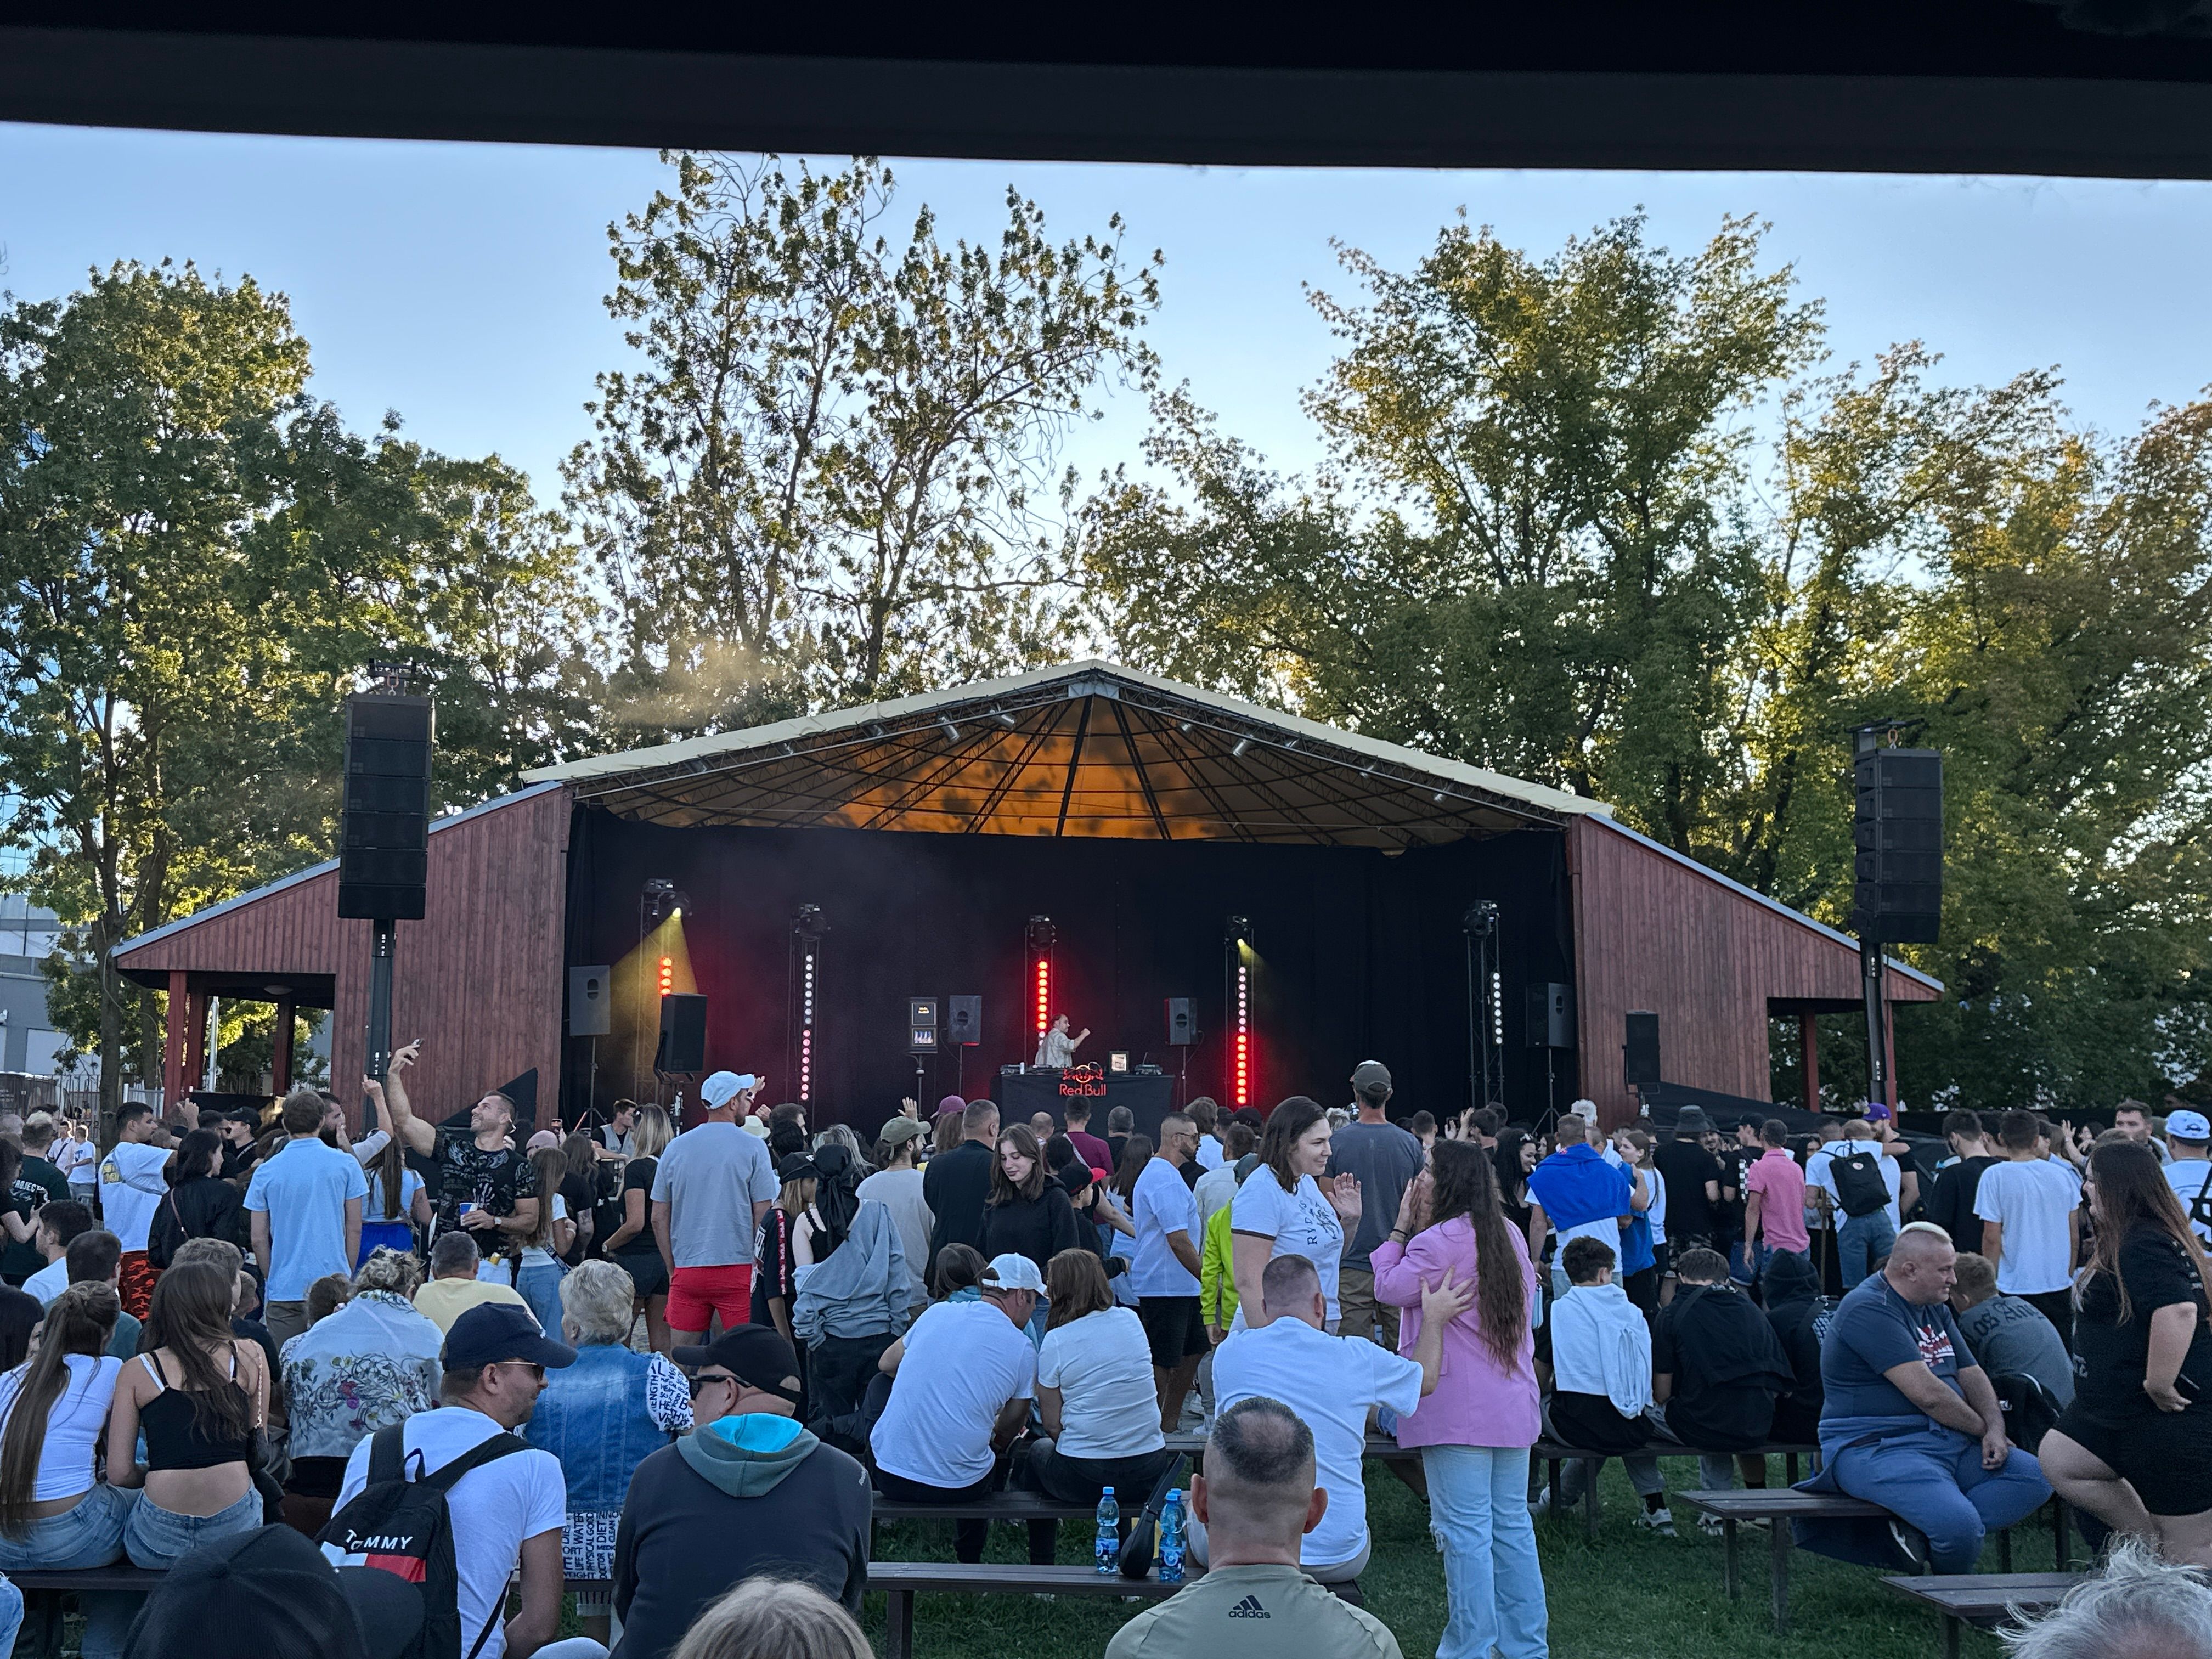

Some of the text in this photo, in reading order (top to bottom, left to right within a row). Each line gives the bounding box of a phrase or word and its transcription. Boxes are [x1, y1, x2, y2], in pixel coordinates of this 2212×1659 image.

[1059, 1084, 1107, 1096] Red Bull
[650, 1375, 658, 1412] ENGTH
[561, 1525, 570, 1544] DIE
[573, 1512, 583, 1544] WATER
[597, 1521, 607, 1543] DIET
[562, 1546, 583, 1555] ORT
[597, 1553, 607, 1579] DOCTOR
[1229, 1610, 1271, 1618] adidas
